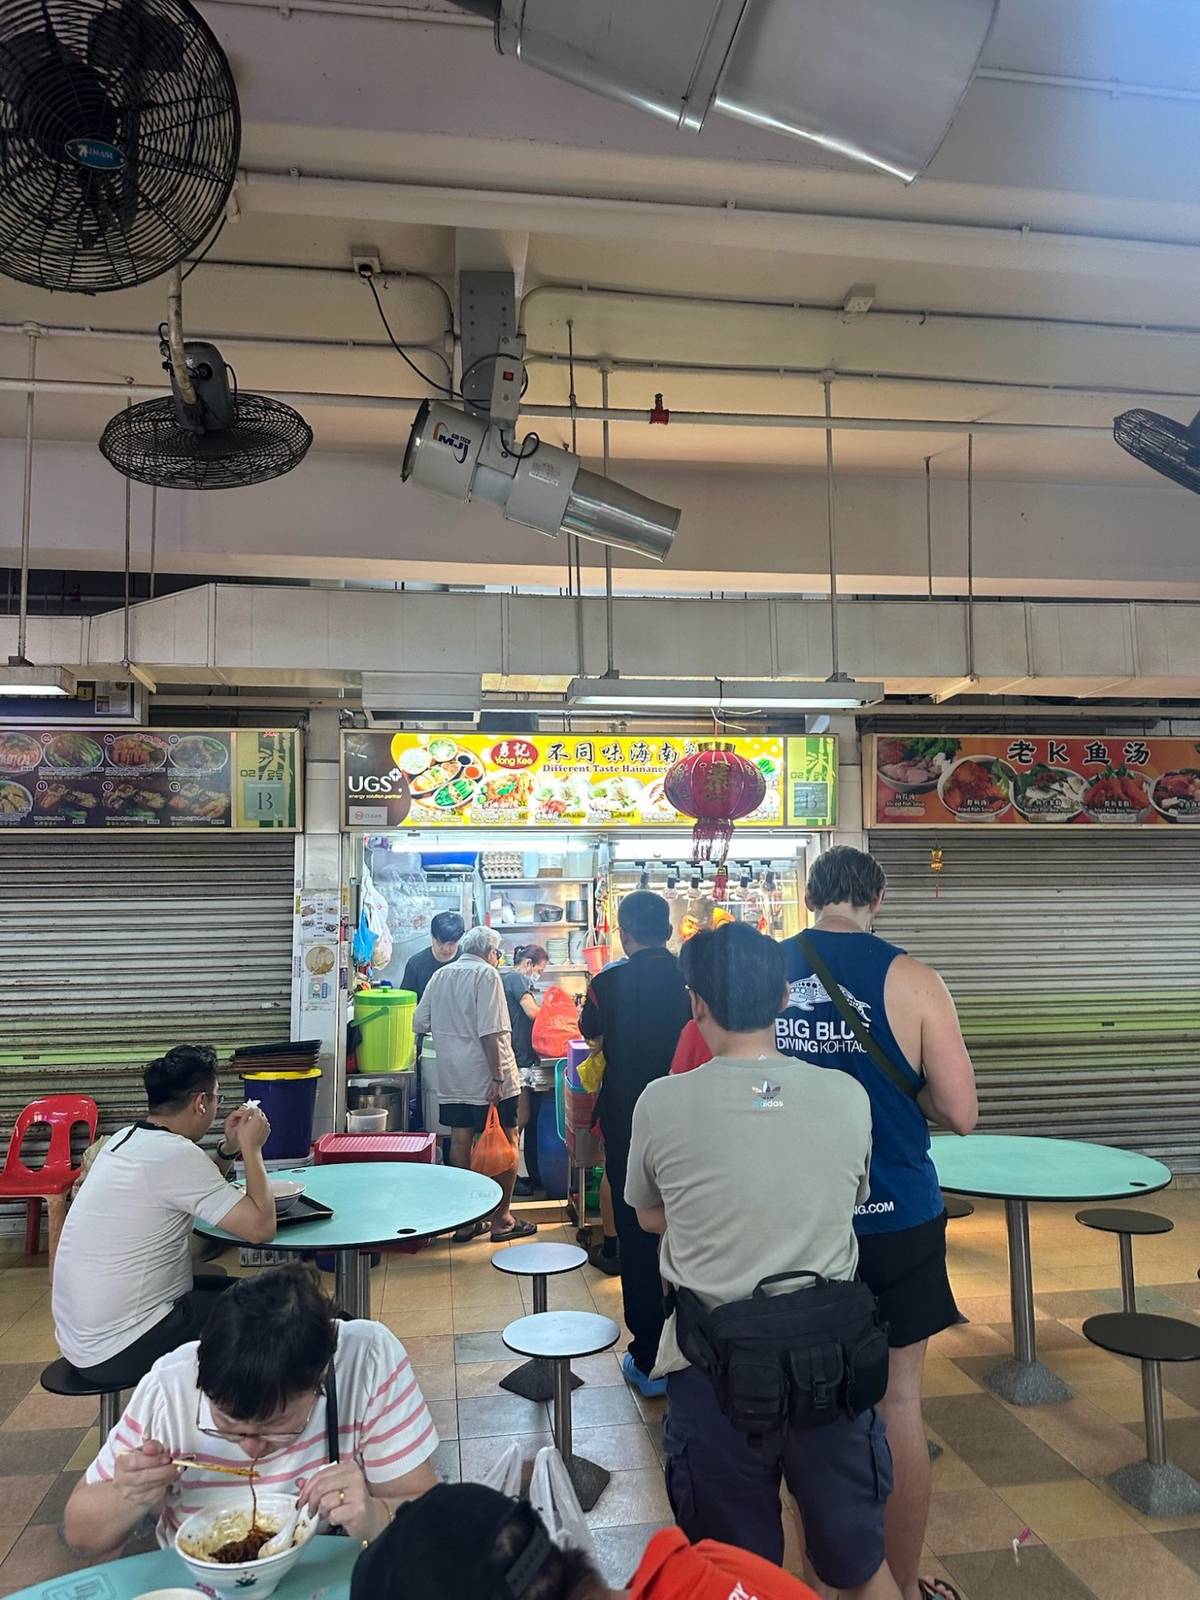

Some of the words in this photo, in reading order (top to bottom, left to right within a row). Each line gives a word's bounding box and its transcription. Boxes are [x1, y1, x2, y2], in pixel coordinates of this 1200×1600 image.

[495, 756, 516, 767] Yong
[517, 756, 533, 765] Kee
[543, 764, 590, 773] Different
[593, 764, 620, 773] Taste
[622, 764, 669, 773] Hainanes
[348, 775, 392, 792] UGS
[348, 793, 366, 801] energy
[775, 1018, 810, 1039] BIG
[777, 1037, 819, 1053] DIVING
[752, 1099, 784, 1108] didas
